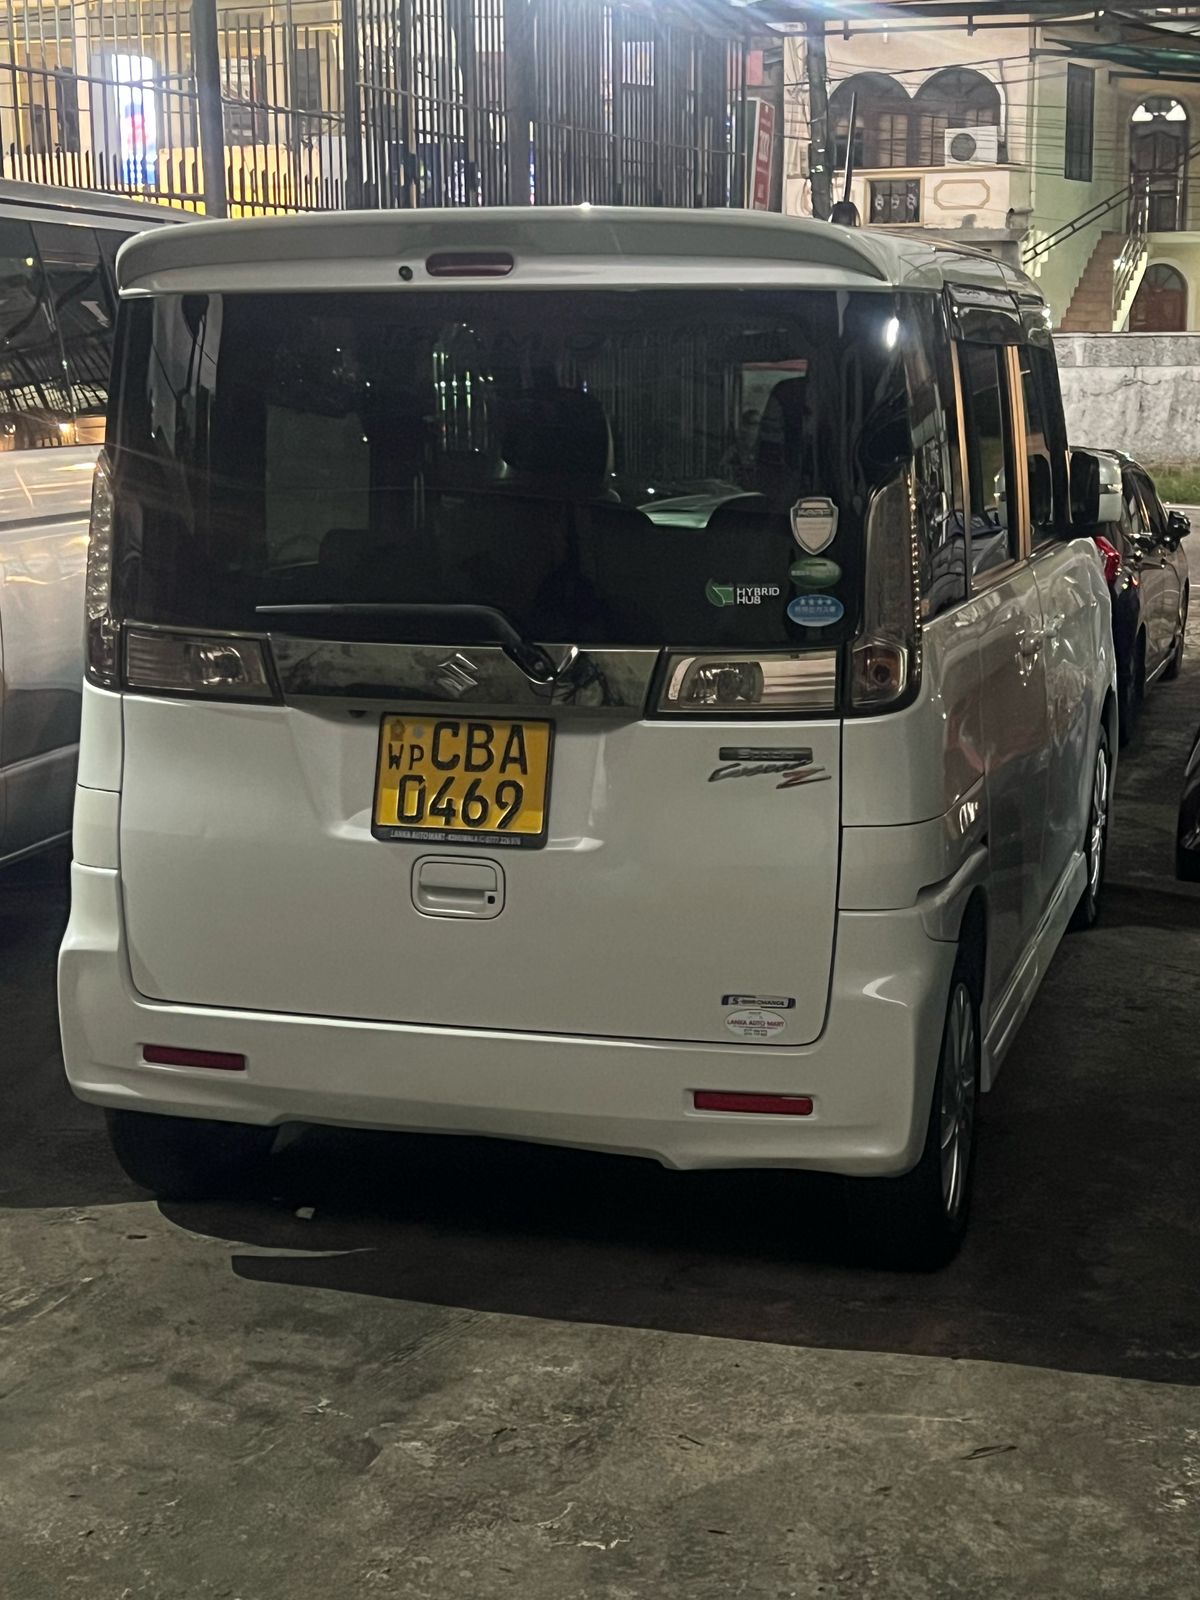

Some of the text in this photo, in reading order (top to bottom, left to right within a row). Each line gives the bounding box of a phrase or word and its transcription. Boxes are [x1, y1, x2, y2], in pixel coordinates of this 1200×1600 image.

[736, 587, 780, 596] HYBRID
[736, 596, 761, 605] HUB
[388, 721, 528, 775] WP CBA
[396, 774, 524, 829] 0469
